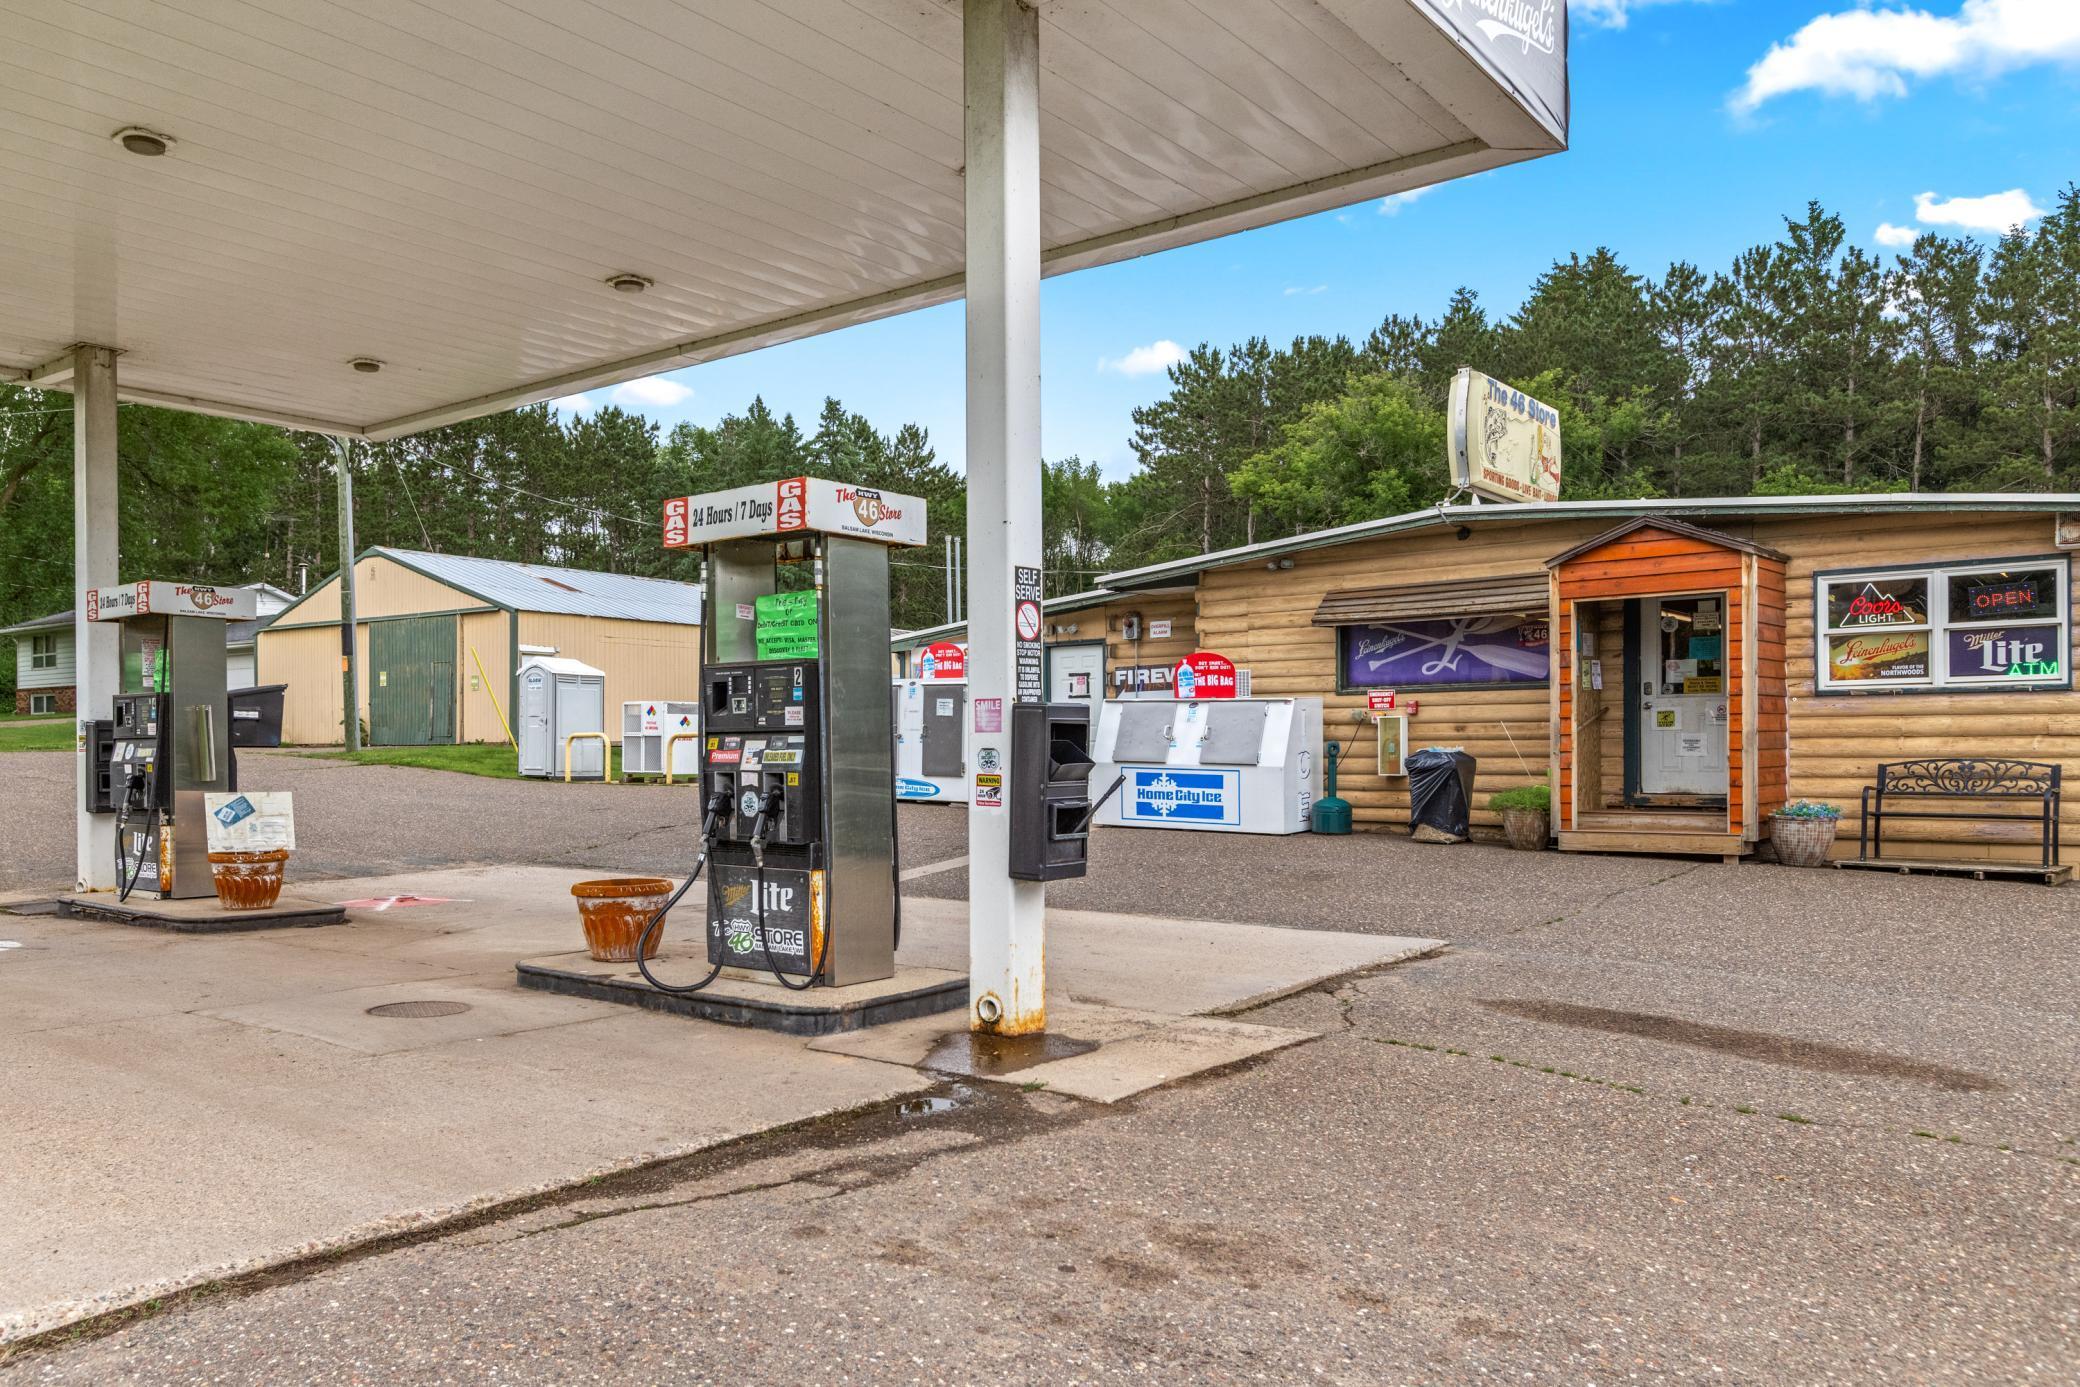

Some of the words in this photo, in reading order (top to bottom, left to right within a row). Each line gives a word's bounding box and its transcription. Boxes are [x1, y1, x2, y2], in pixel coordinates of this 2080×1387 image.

[1488, 378, 1507, 407] The
[1511, 391, 1525, 415] 46
[1529, 399, 1557, 430] Store
[1483, 467, 1504, 486] SPORTING
[1505, 477, 1520, 492] GOODS
[1522, 483, 1532, 496] LIVE
[1533, 487, 1542, 500] BAIT
[857, 490, 879, 499] HWY
[693, 507, 704, 527] 24
[706, 505, 733, 525] Hours
[741, 501, 746, 520] 7
[749, 499, 773, 524] Days
[779, 481, 802, 529] GAS
[836, 488, 857, 503] The
[858, 500, 878, 520] 46
[880, 504, 903, 521] Store
[665, 501, 686, 544] GAS
[1018, 569, 1037, 584] SELF
[137, 583, 149, 612] GAS
[176, 586, 193, 596] The
[195, 593, 212, 605] 46
[212, 594, 234, 605] Store
[1016, 584, 1040, 600] SERVE
[1976, 590, 2032, 608] OPEN
[87, 592, 98, 620] GAS
[1850, 596, 1903, 616] Coors
[1859, 613, 1894, 624] LIGHT
[1534, 629, 1548, 639] 46
[1964, 631, 2006, 650] Miller
[1024, 642, 1040, 650] SMOKING
[1840, 633, 1917, 664] Leinenkugel's
[1980, 640, 2044, 672] Lite
[795, 668, 802, 686] 2
[2008, 662, 2059, 676] ATM
[1194, 676, 1205, 686] THE
[1207, 674, 1218, 686] BIG
[1220, 676, 1233, 686] BAG
[976, 700, 1000, 710] SMILE
[711, 751, 739, 759] Premium
[1137, 788, 1174, 800] Home
[1175, 790, 1200, 804] City
[1202, 791, 1222, 803] Ice
[133, 832, 152, 856] Lite
[750, 880, 794, 918] Lite
[712, 920, 732, 936] Te
[728, 932, 754, 952] 46
